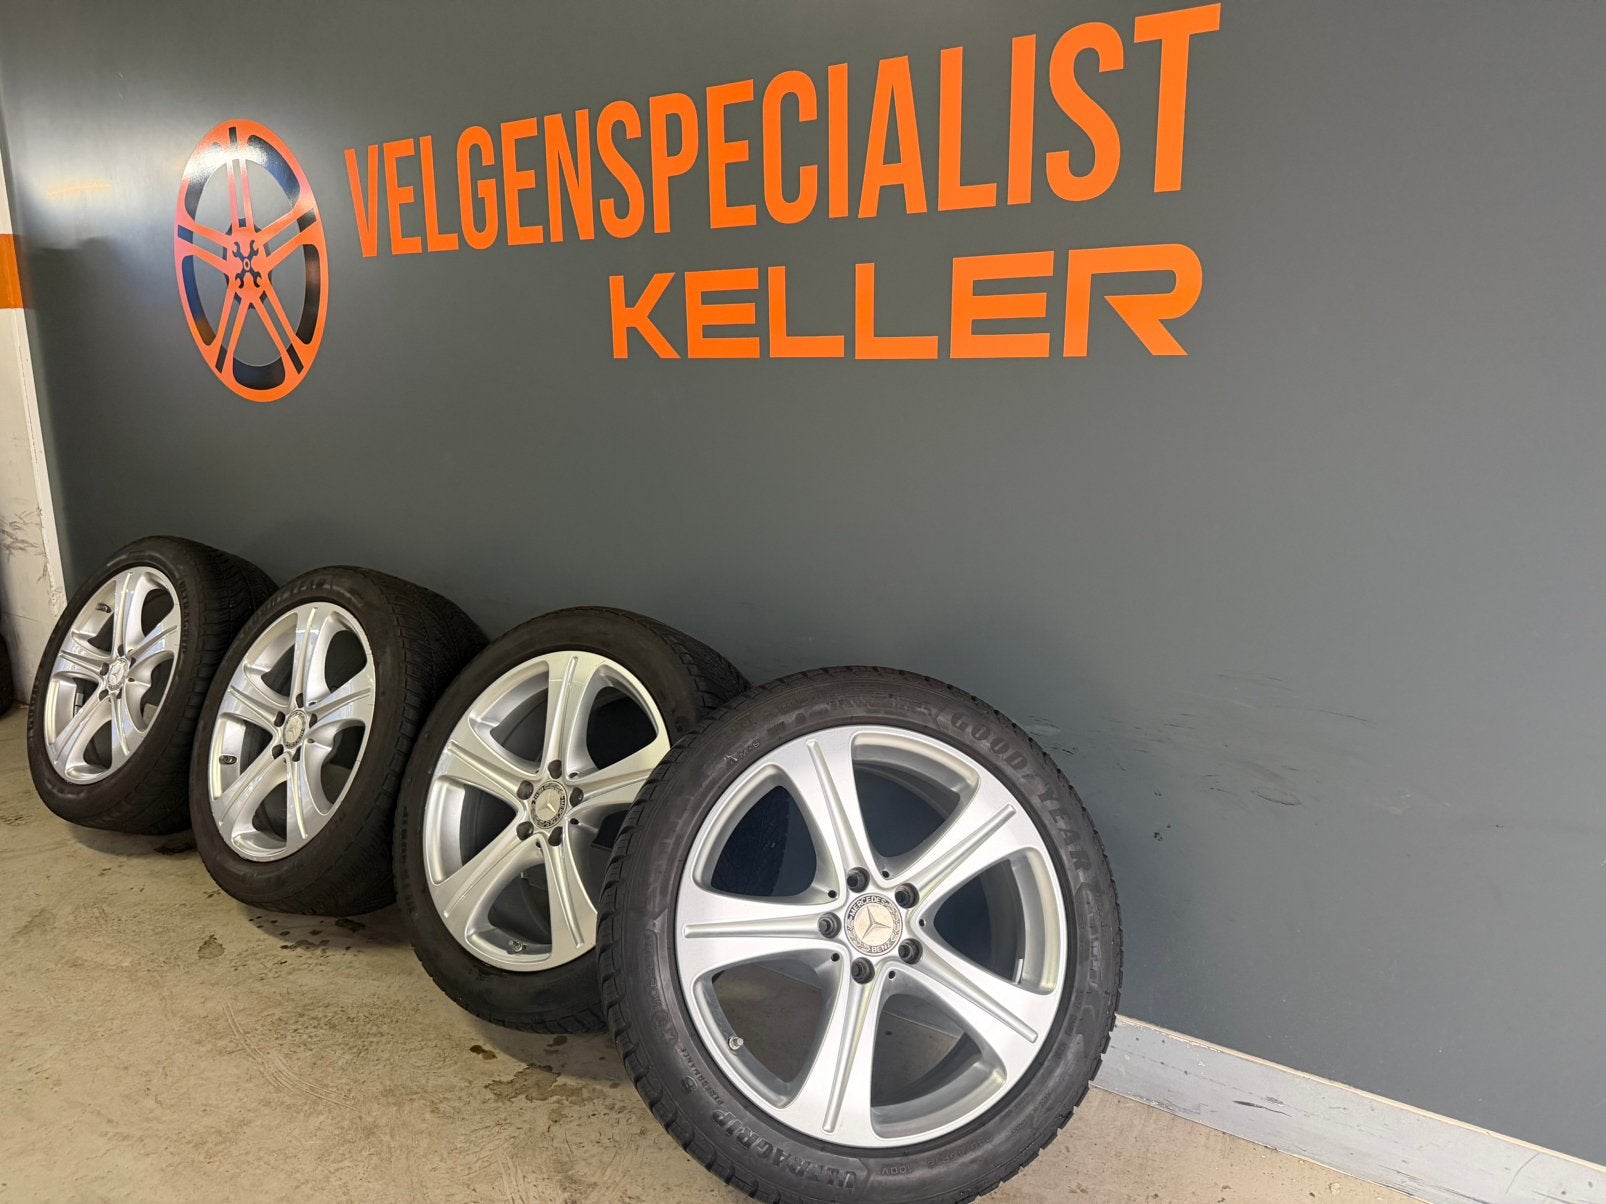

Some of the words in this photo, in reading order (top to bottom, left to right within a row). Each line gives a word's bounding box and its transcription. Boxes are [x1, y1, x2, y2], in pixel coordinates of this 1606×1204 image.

[345, 4, 1222, 259] VELGENSPECIALIST
[609, 244, 1204, 361] KELLER
[848, 895, 890, 920] MERCEDES
[680, 1046, 725, 1106] PERFORMANCE
[711, 1109, 858, 1189] ULTRAGRIP
